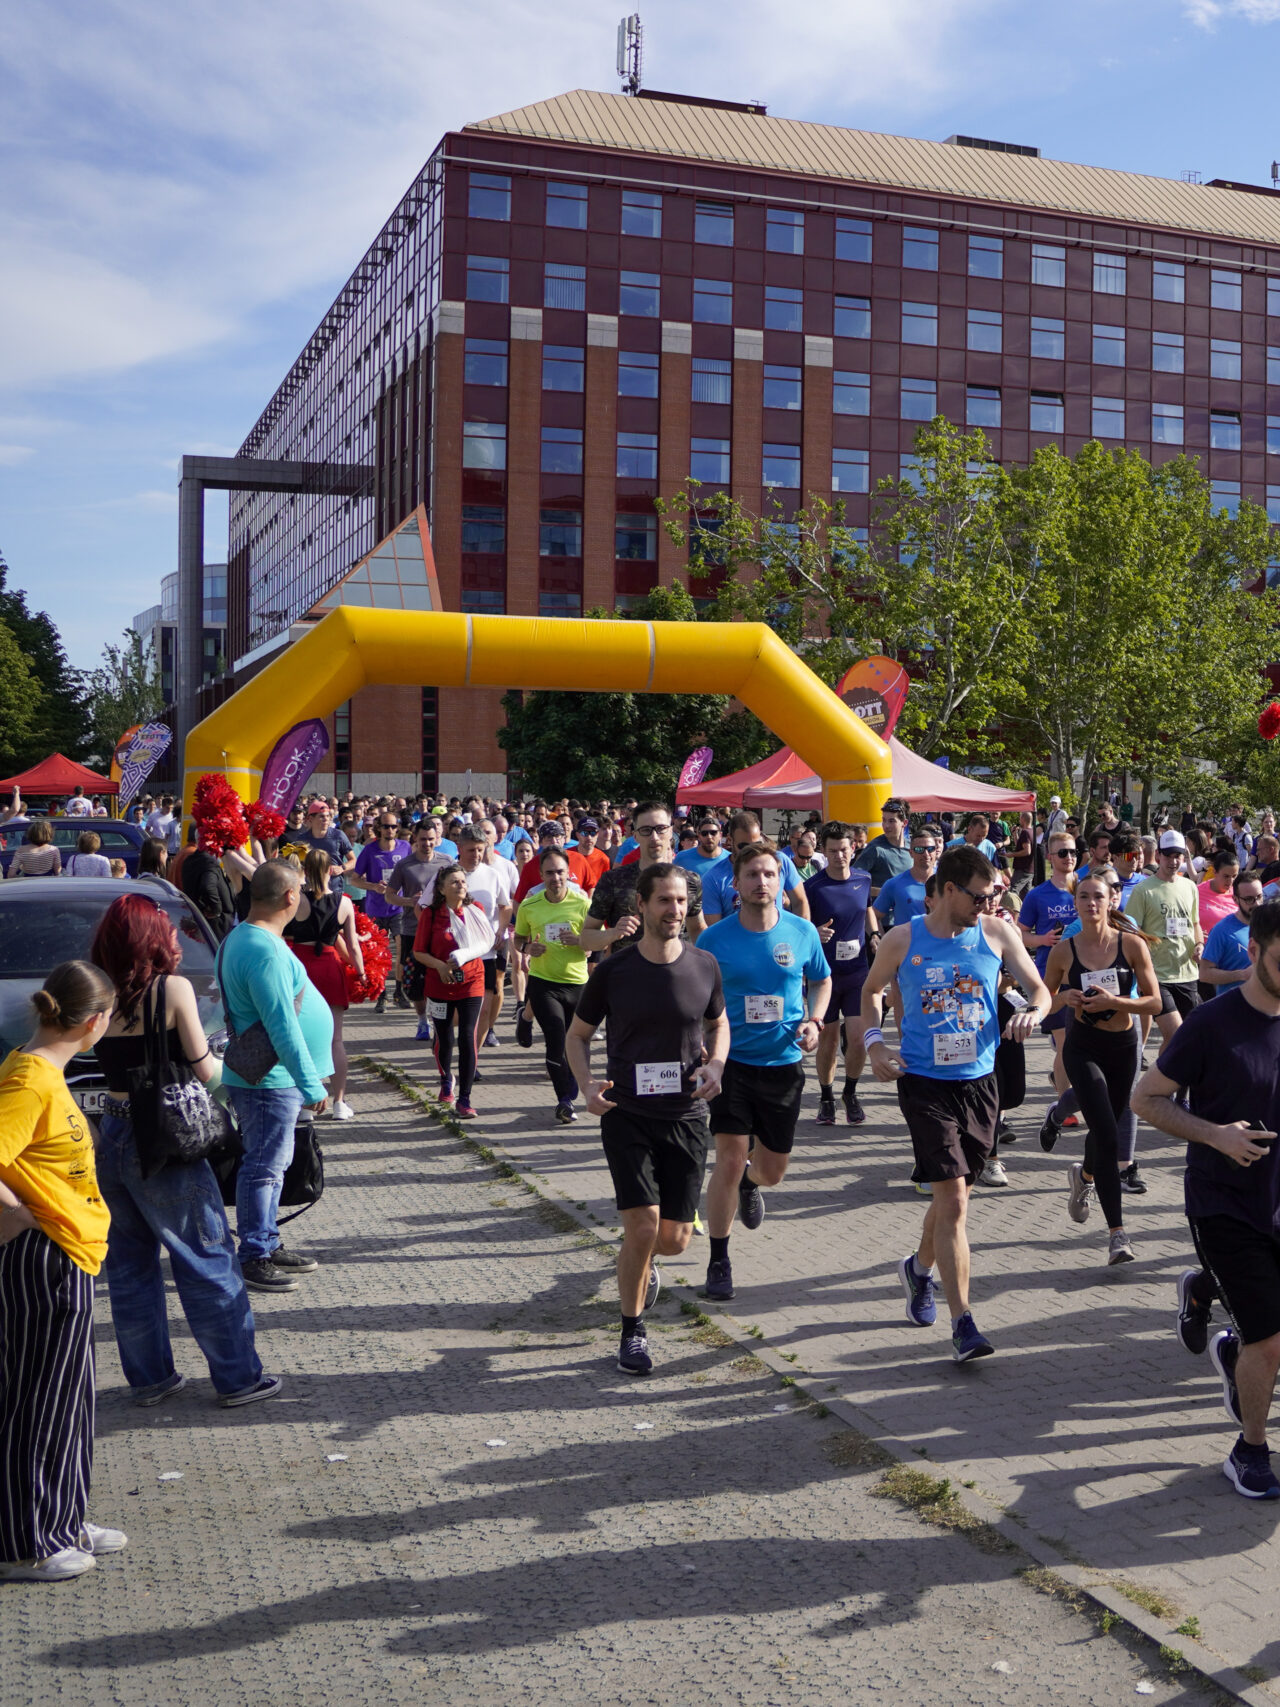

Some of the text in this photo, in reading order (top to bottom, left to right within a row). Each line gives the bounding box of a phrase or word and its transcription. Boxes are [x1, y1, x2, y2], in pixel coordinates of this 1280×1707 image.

[1101, 974, 1116, 984] 652
[763, 999, 779, 1008] 855
[955, 1038, 971, 1049] 573
[660, 1069, 678, 1079] 606
